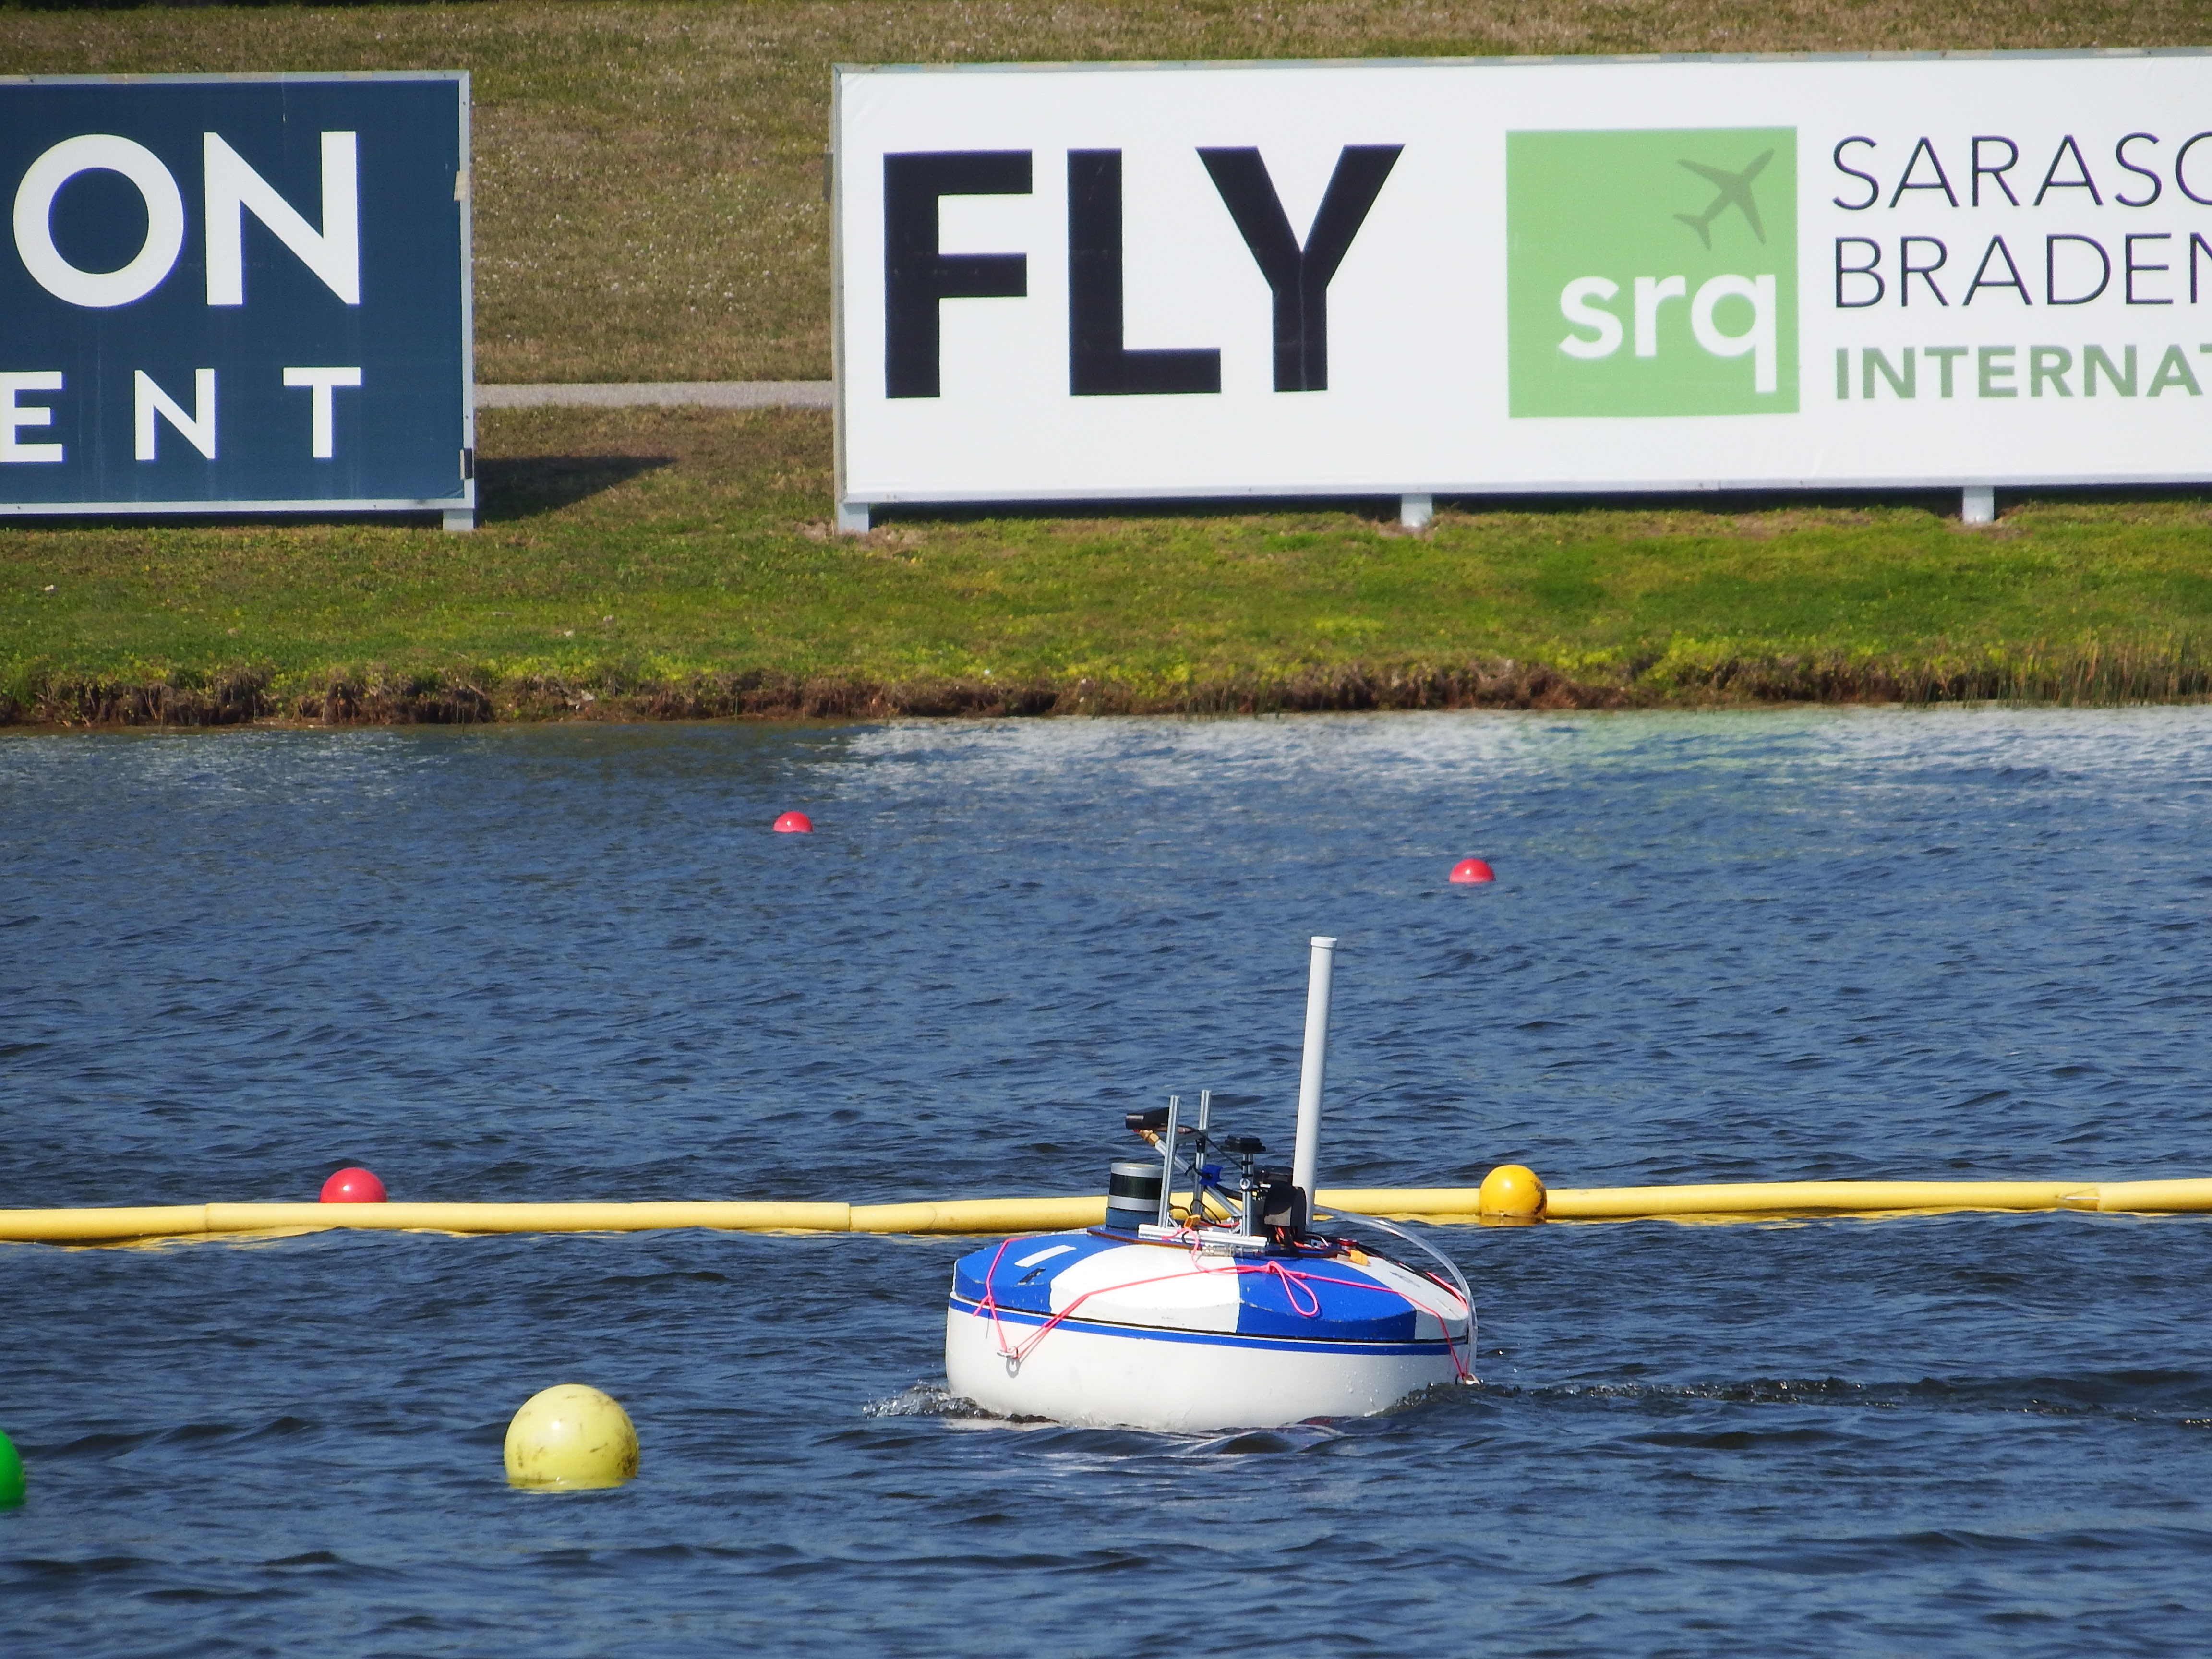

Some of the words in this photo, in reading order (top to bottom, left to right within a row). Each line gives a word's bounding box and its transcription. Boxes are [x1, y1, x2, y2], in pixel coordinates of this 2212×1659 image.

[13, 131, 360, 307] ON
[883, 144, 1406, 399] FLY
[1559, 274, 1777, 393] srq
[1836, 343, 2212, 400] INTERNA
[0, 367, 361, 463] ENT
